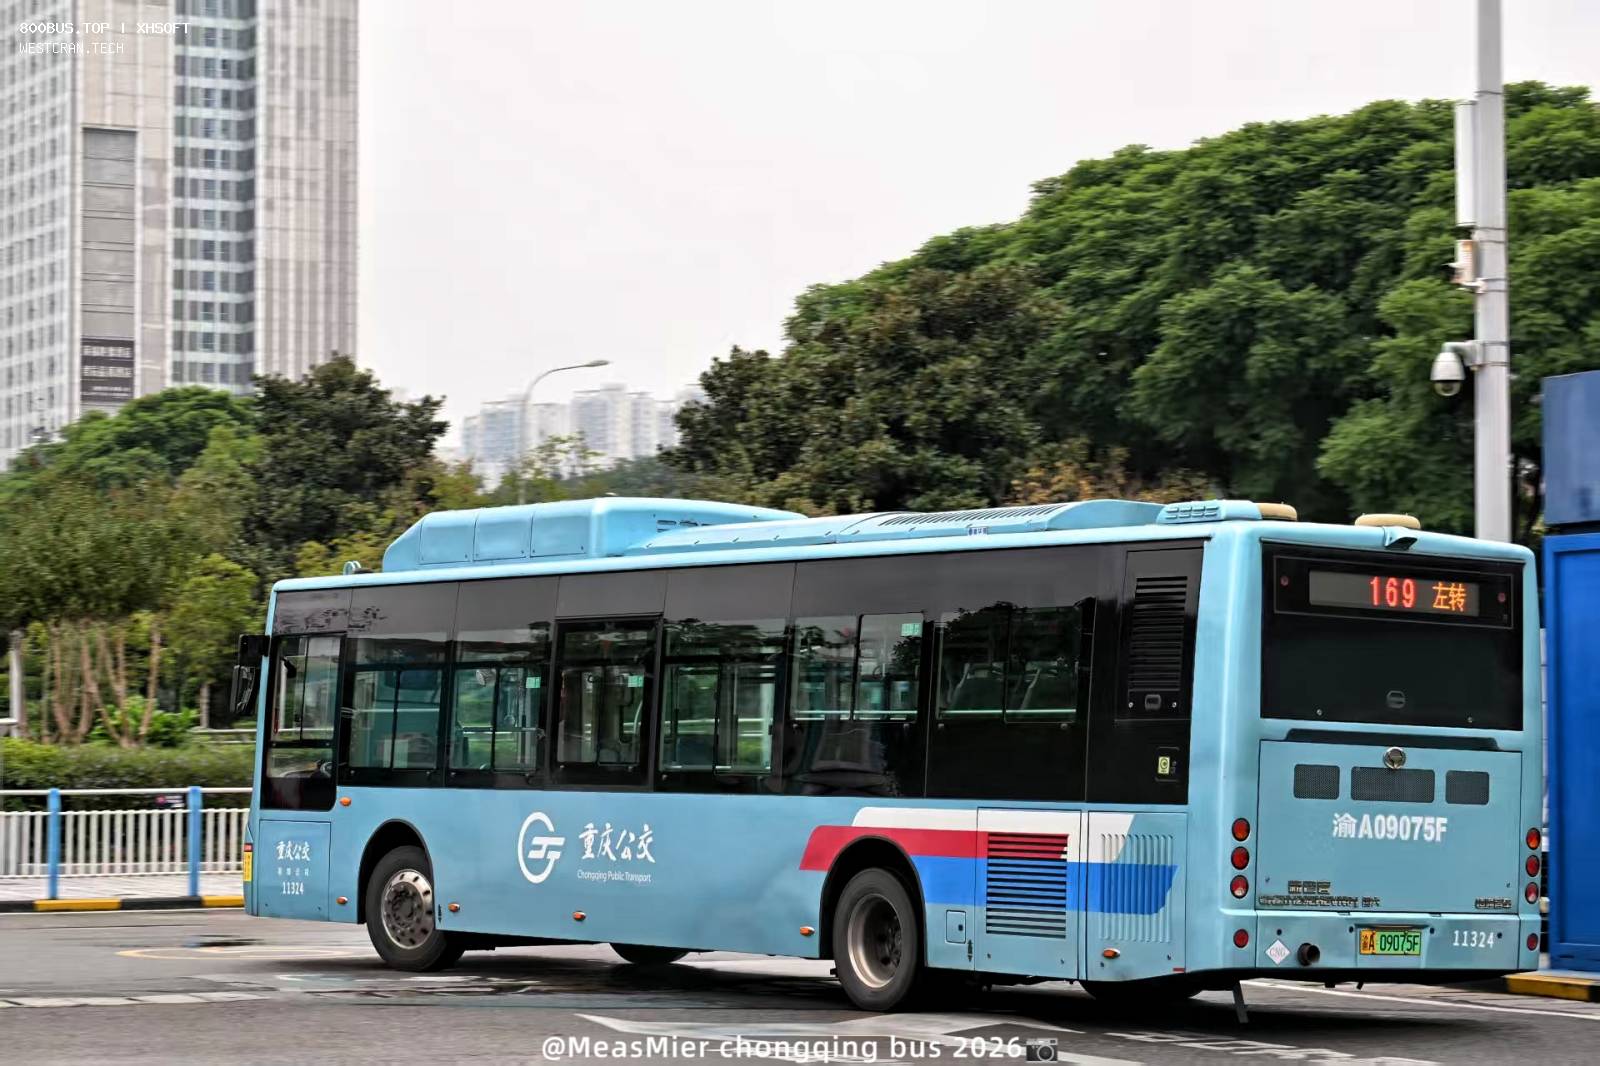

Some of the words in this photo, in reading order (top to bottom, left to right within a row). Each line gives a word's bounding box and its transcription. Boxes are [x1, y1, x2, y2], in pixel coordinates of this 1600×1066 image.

[1370, 576, 1417, 608] 169
[1432, 582, 1467, 612] 左转
[1332, 813, 1448, 842] 渝A09075F
[276, 840, 311, 861] 重庆公交
[578, 822, 655, 863] 重庆公交
[577, 869, 607, 882] Chongqing
[607, 871, 624, 881] Public
[625, 872, 652, 883] Transport
[282, 881, 304, 895] 11324
[1452, 929, 1495, 949] 11324
